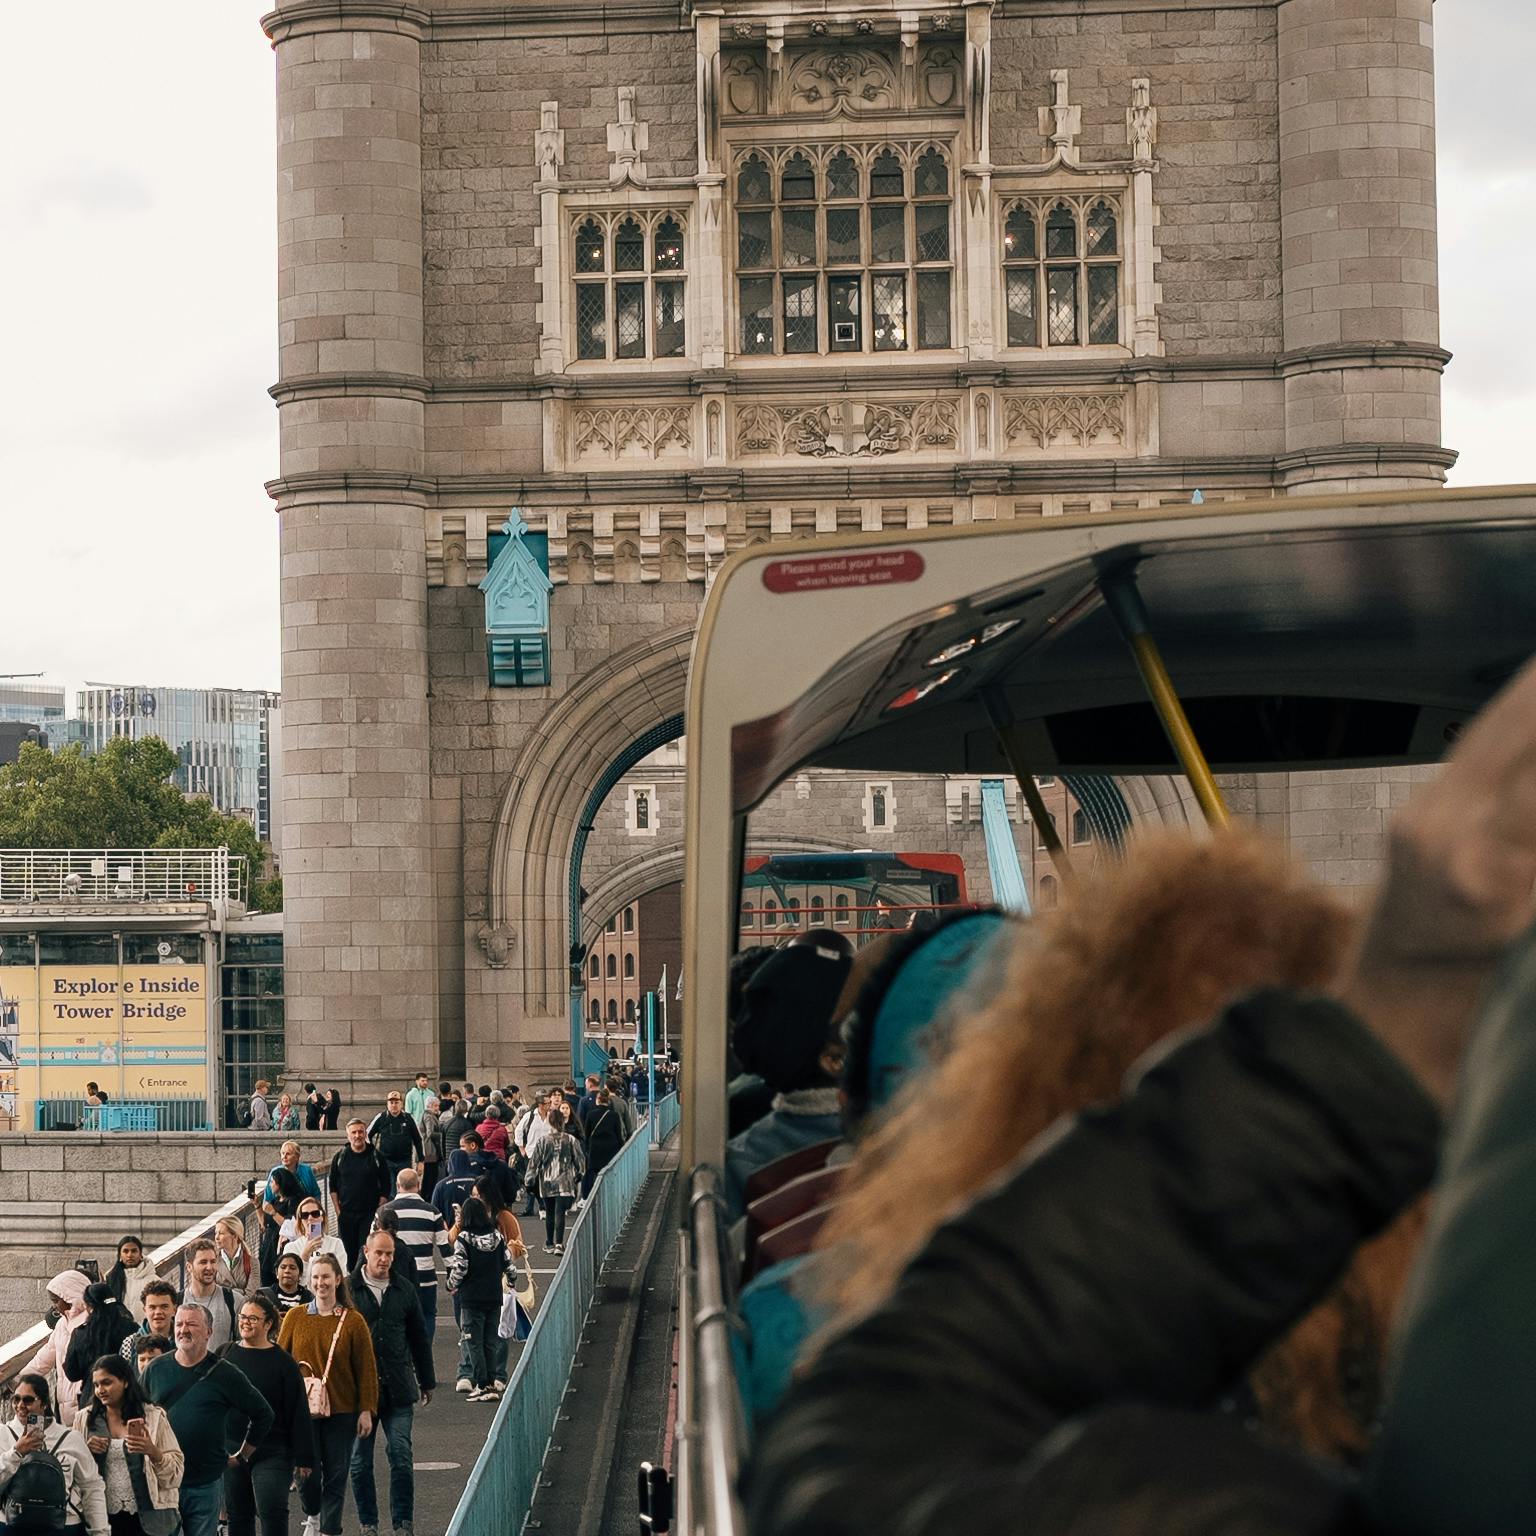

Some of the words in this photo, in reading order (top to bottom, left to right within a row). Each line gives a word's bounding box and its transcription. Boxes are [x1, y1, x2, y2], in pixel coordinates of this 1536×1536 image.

[818, 559, 847, 571] mind
[849, 558, 875, 571] your
[877, 554, 905, 566] head
[53, 978, 134, 996] Explore
[139, 977, 200, 993] Inside
[53, 1004, 114, 1019] Tower
[122, 1002, 187, 1021] Bridge
[147, 1078, 188, 1087] Entrance
